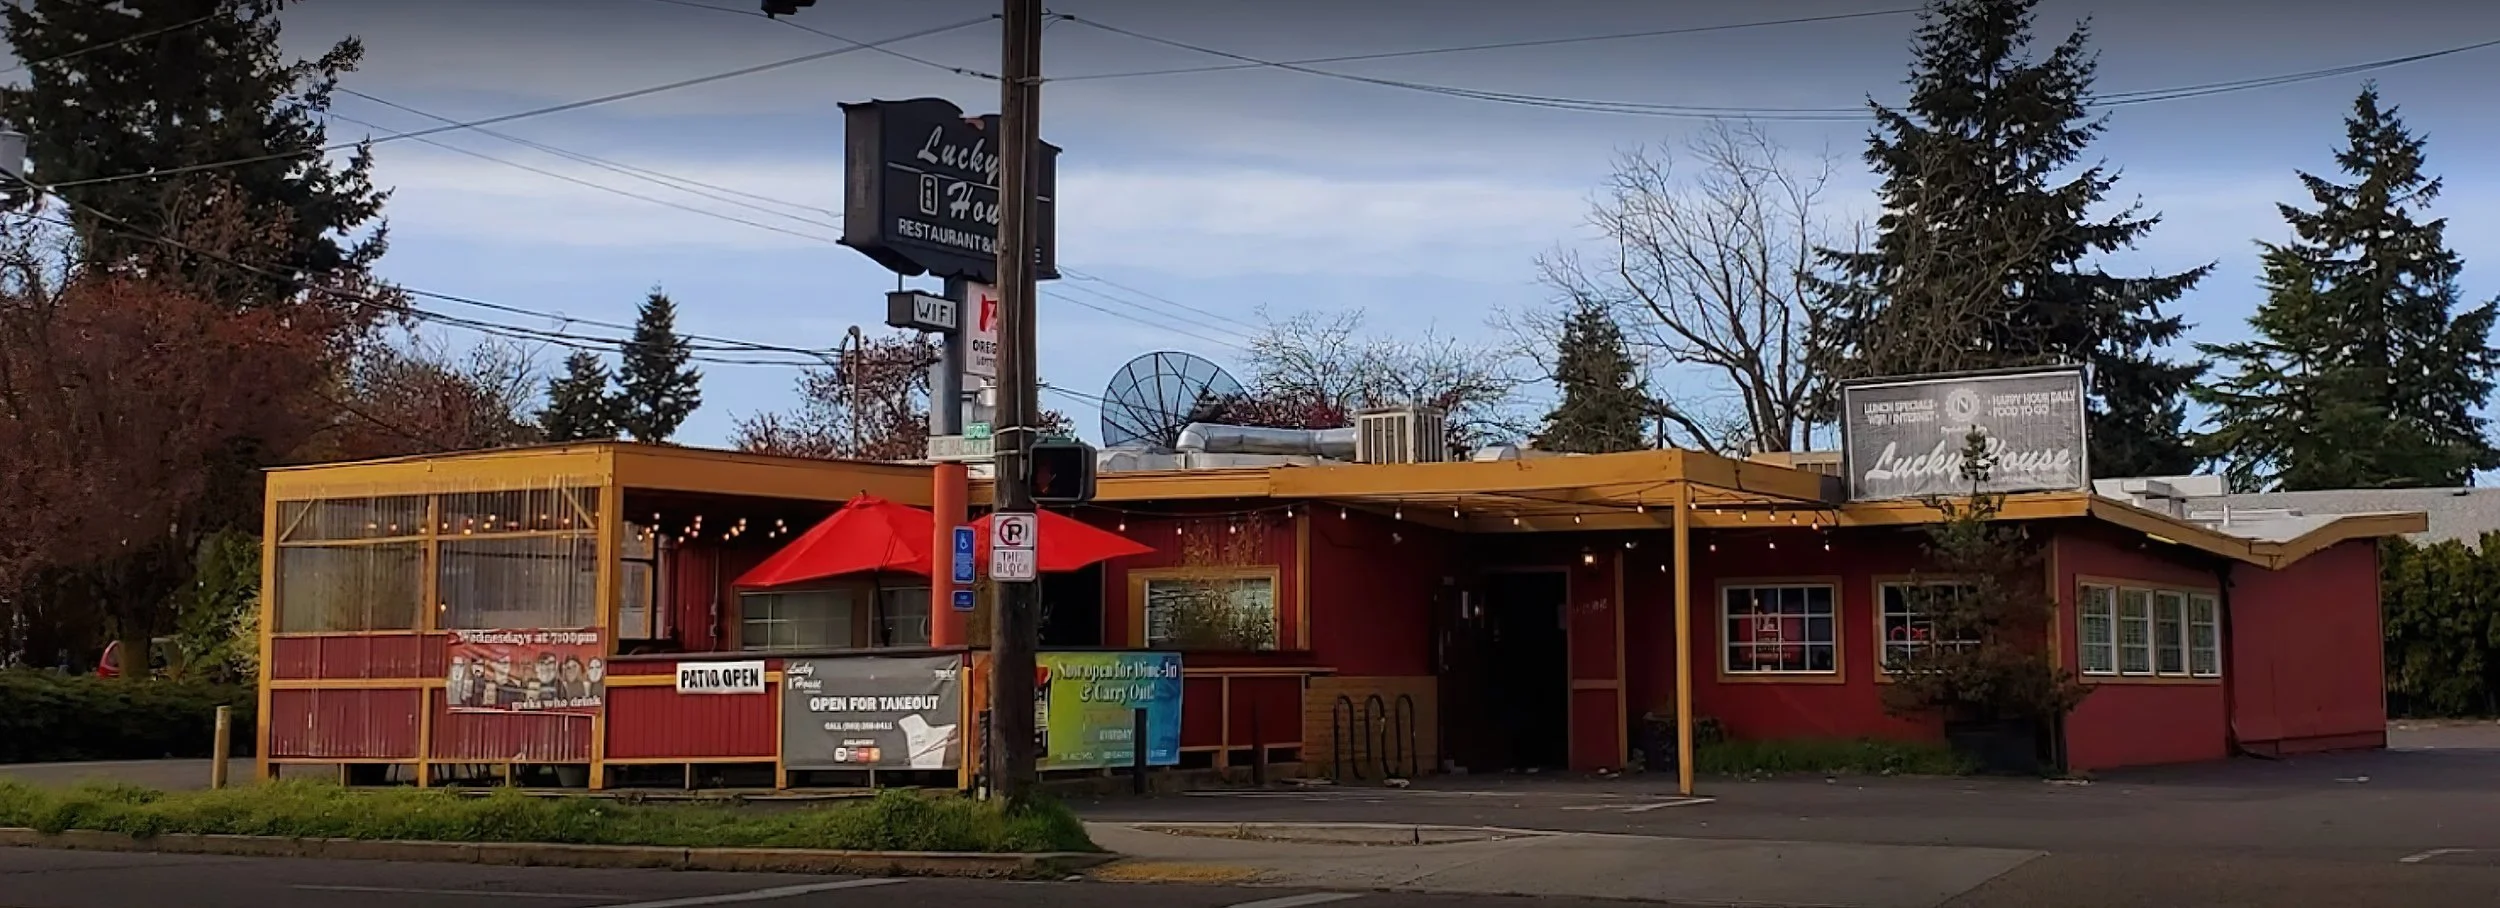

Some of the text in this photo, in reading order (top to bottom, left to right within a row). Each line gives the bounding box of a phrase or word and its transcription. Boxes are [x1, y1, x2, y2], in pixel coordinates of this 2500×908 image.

[917, 125, 998, 185] Lucky
[947, 181, 999, 225] Hou
[898, 218, 981, 251] RESTAURANT
[916, 300, 953, 325] WIFI
[973, 339, 997, 354] OREG
[1865, 436, 2072, 484] Lucky House
[681, 668, 759, 688] PATIO OPEN
[1115, 661, 1132, 678] for
[810, 694, 940, 711] OPEN FOR TAKEOUT
[1094, 683, 1128, 705] Carry
